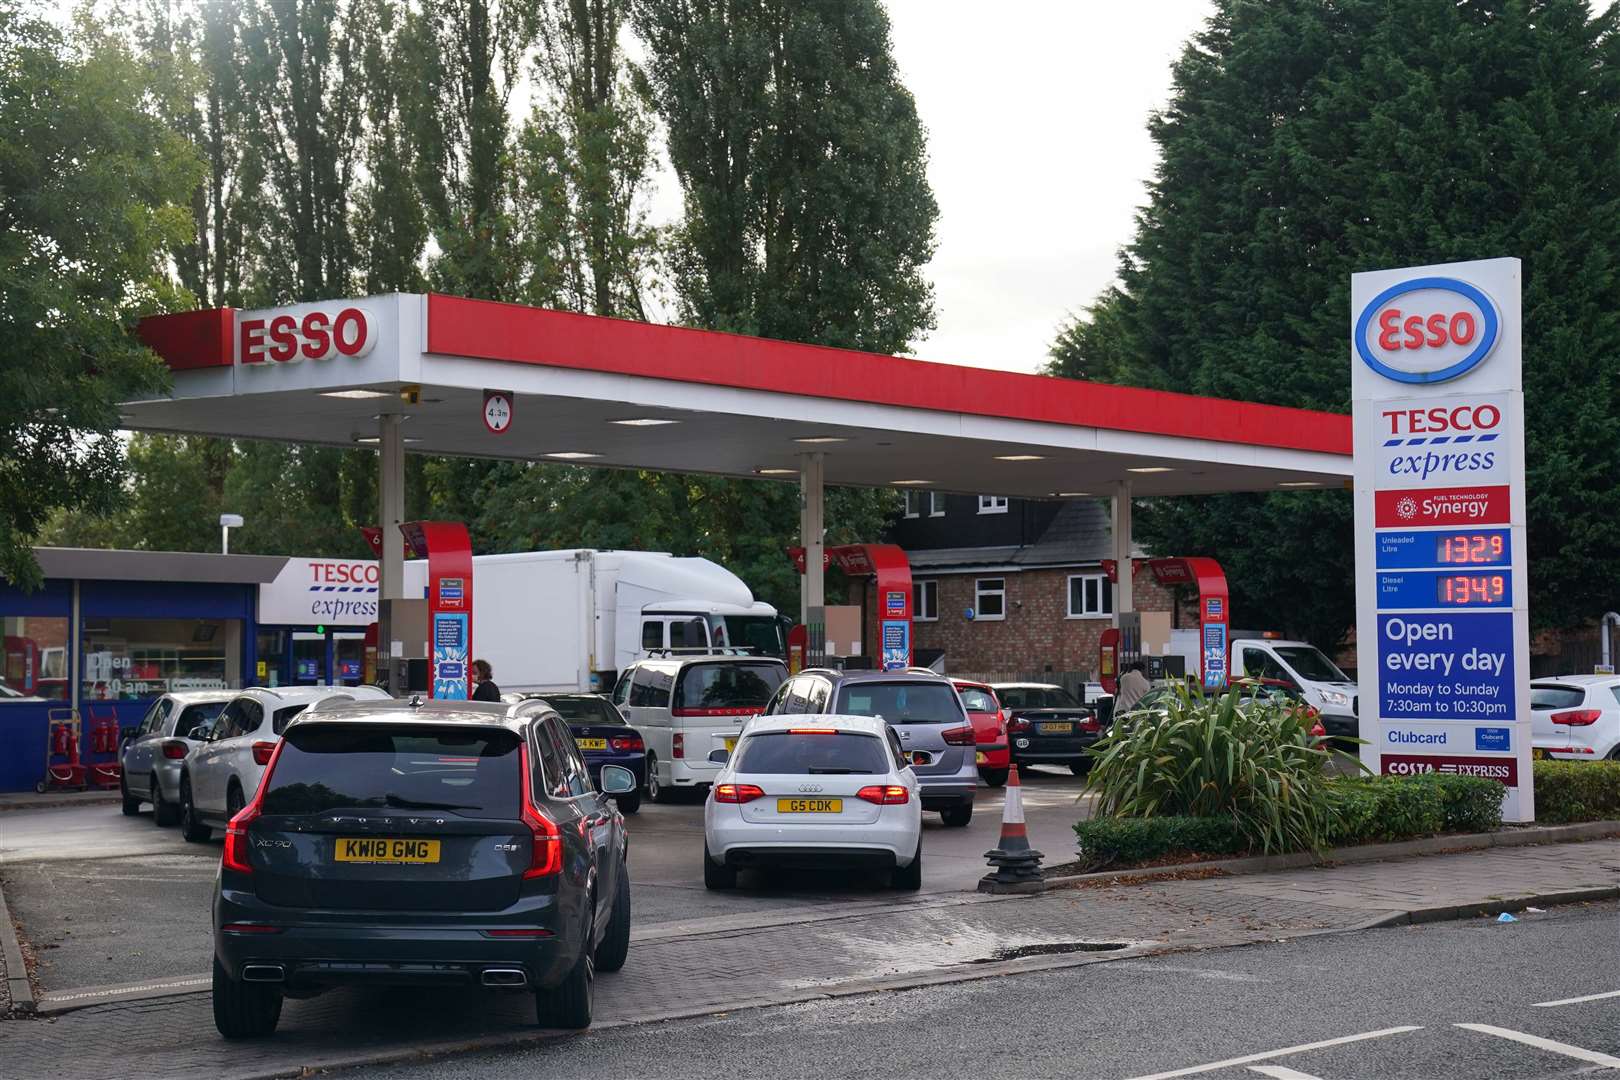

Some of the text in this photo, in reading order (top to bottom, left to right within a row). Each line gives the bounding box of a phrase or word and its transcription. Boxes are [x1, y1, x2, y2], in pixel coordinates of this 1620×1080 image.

[241, 308, 367, 364] ESSO
[1383, 404, 1501, 435] TESCO
[1390, 451, 1495, 480] express
[1422, 499, 1489, 519] Synergy
[1382, 536, 1414, 544] Unleaded
[1445, 535, 1503, 562] 132.9
[309, 563, 380, 583] TESCO
[1382, 576, 1403, 584] Diesel
[1446, 576, 1504, 603] 134.9
[312, 599, 376, 620] express
[1385, 618, 1453, 646] Open
[1386, 648, 1506, 677] every day
[1387, 683, 1500, 698] Monday to Sunday
[1387, 700, 1507, 716] 7:30am to 10:30pm
[1388, 731, 1447, 744] Clubcard
[1458, 764, 1510, 778] EXPRESS
[791, 800, 832, 811] G5 CDK
[345, 841, 428, 858] KW18 GMG
